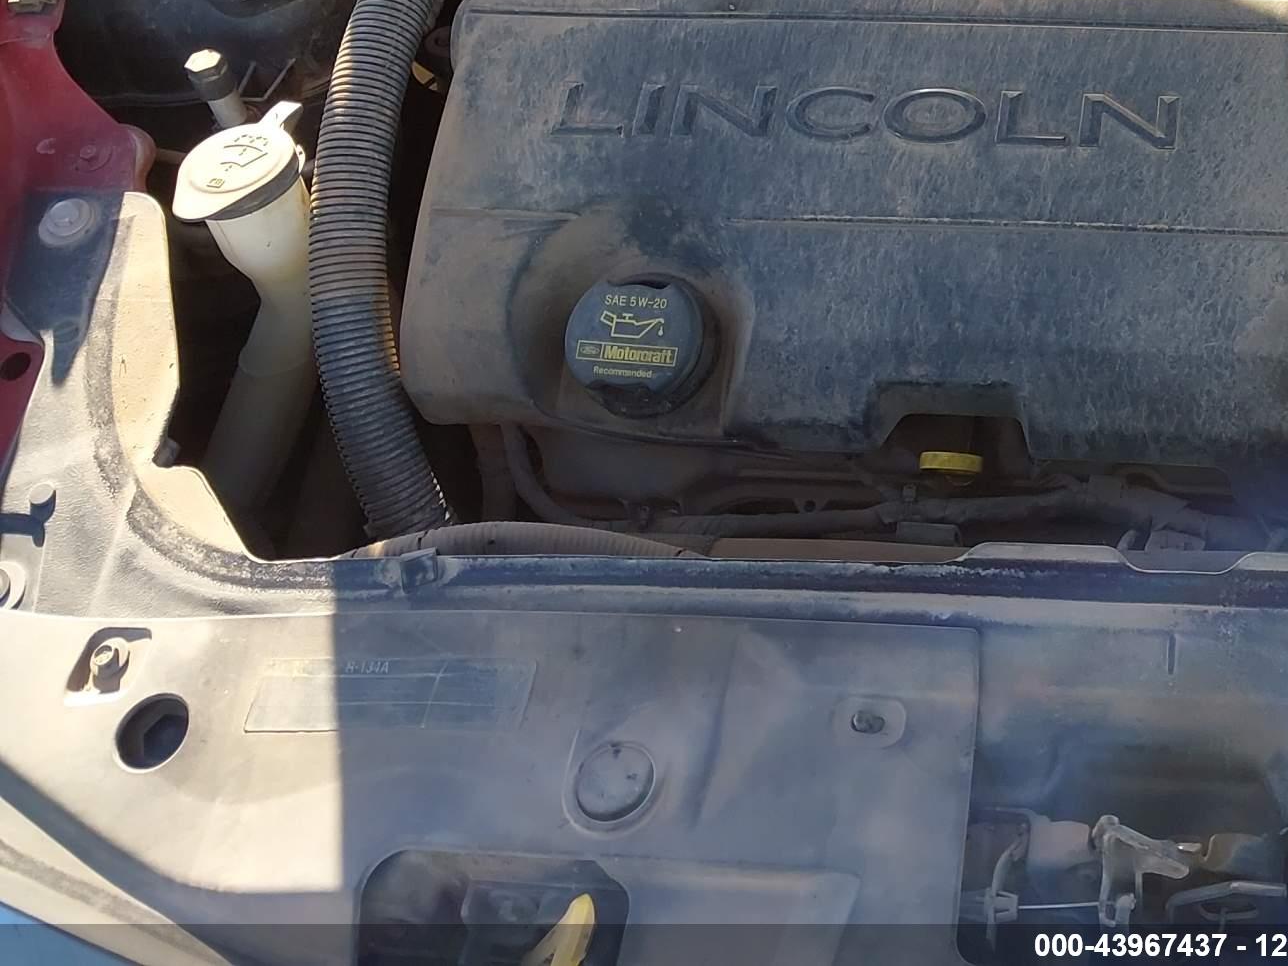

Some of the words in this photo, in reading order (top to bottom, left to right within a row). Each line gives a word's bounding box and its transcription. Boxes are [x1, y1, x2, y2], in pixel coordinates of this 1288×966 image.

[550, 80, 1179, 150] LINCOLN
[604, 294, 627, 307] SAE
[629, 296, 668, 309] 5W-20
[604, 345, 673, 364] Motorcraft
[593, 365, 653, 379] Recommended
